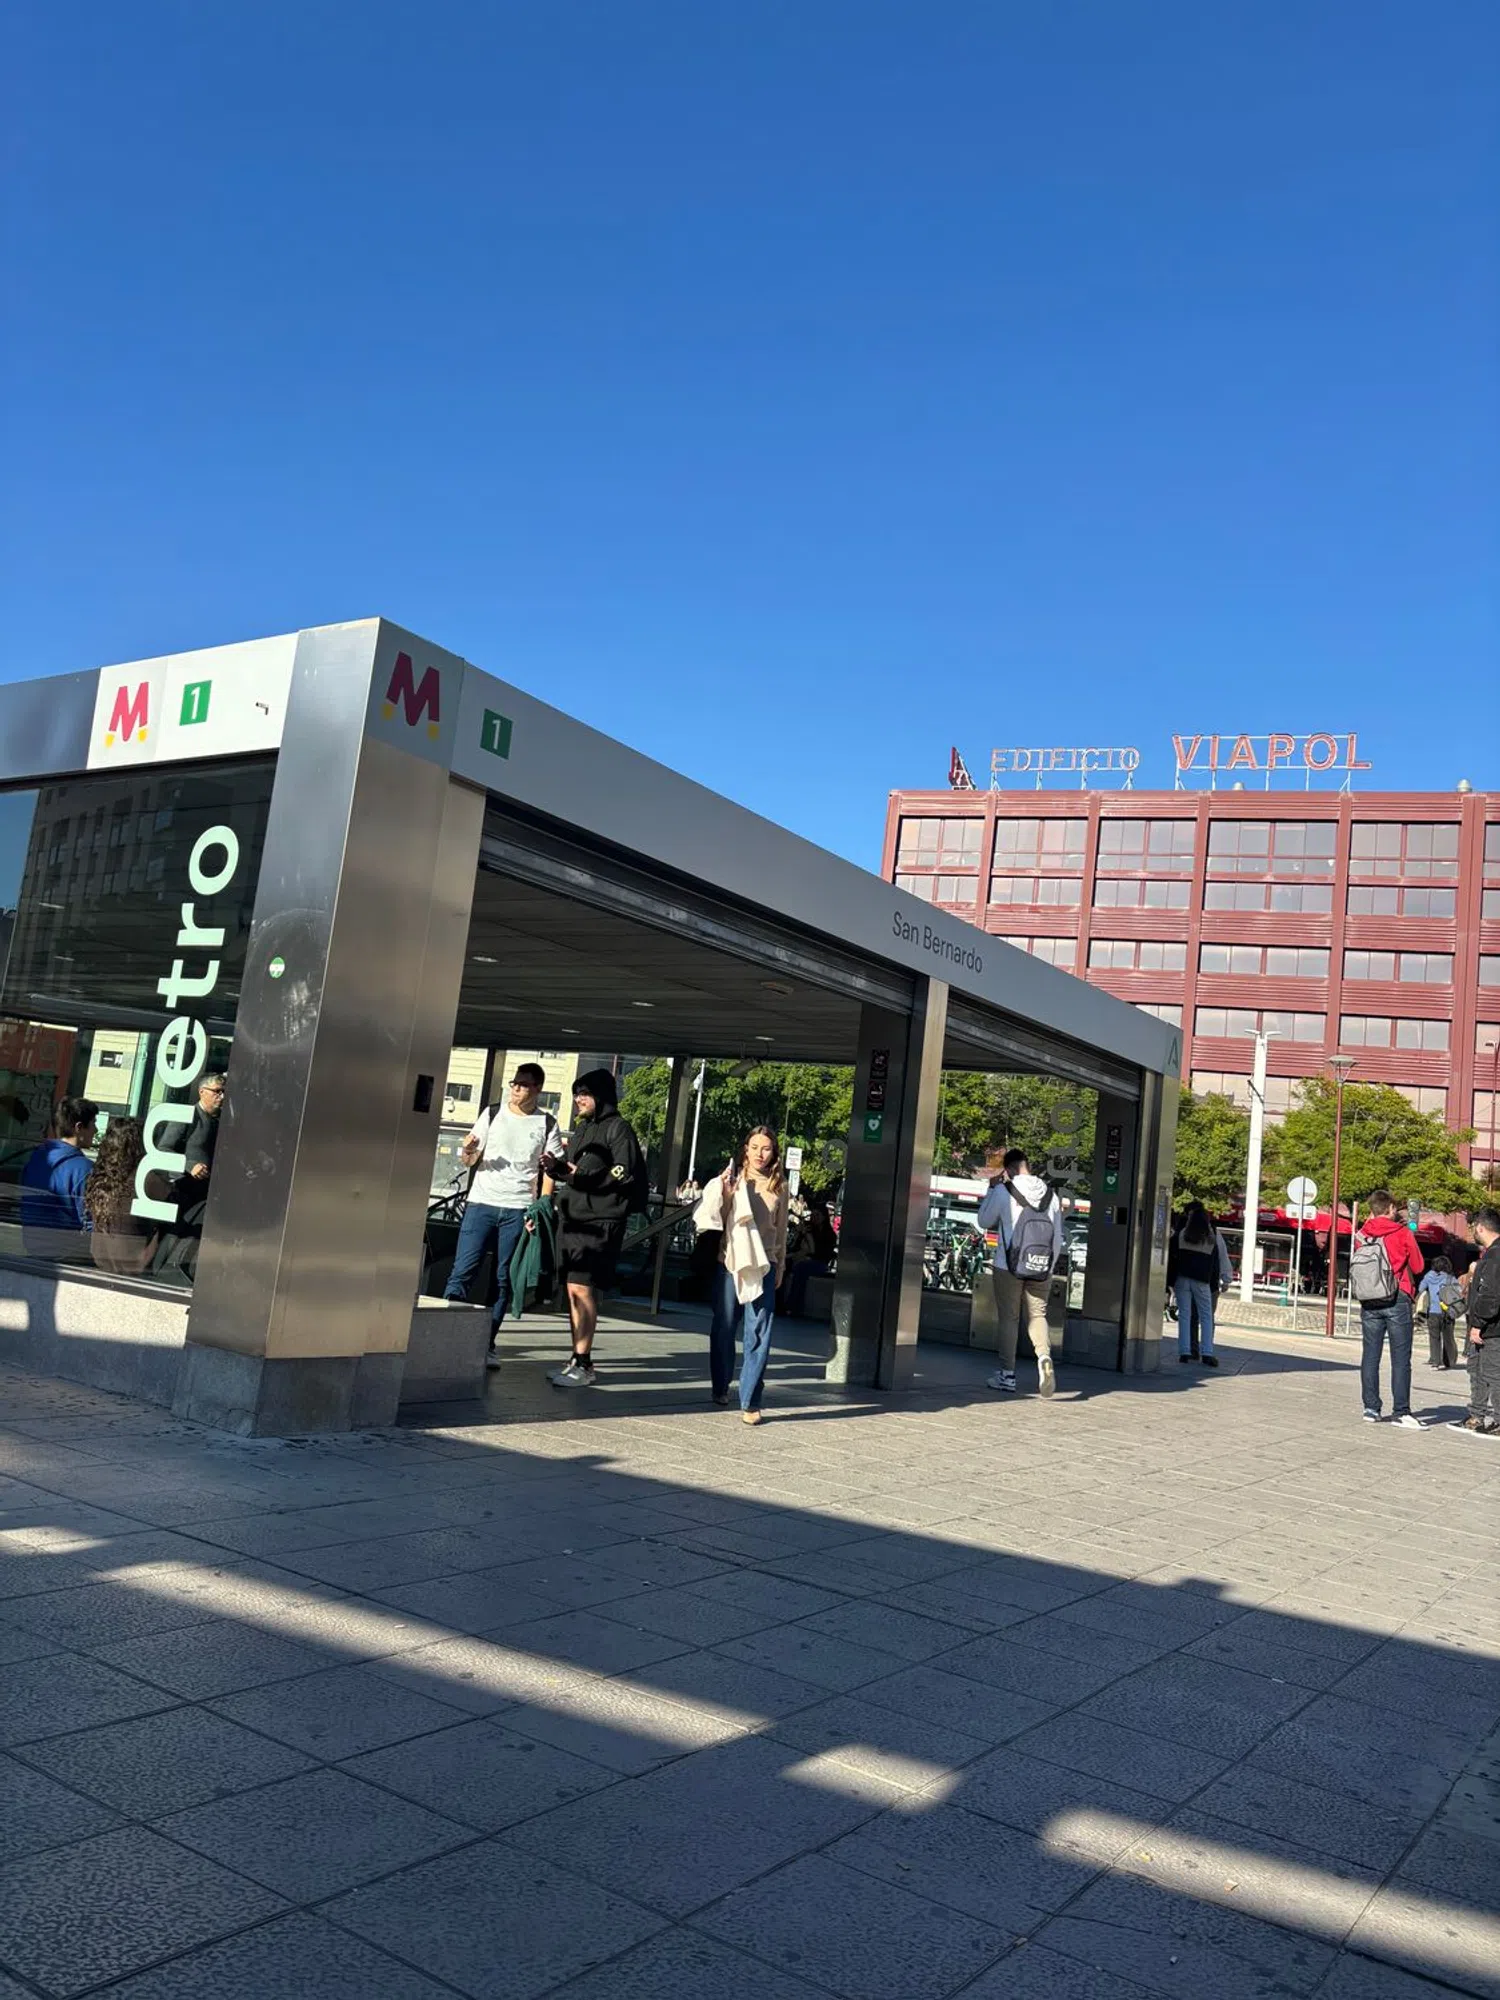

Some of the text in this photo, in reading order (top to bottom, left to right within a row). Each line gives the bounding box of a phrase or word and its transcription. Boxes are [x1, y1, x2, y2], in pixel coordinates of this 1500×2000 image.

[990, 733, 1372, 772] EDIFICIO VIAPOL
[892, 910, 983, 974] San Bernardo
[130, 825, 240, 1223] metro
